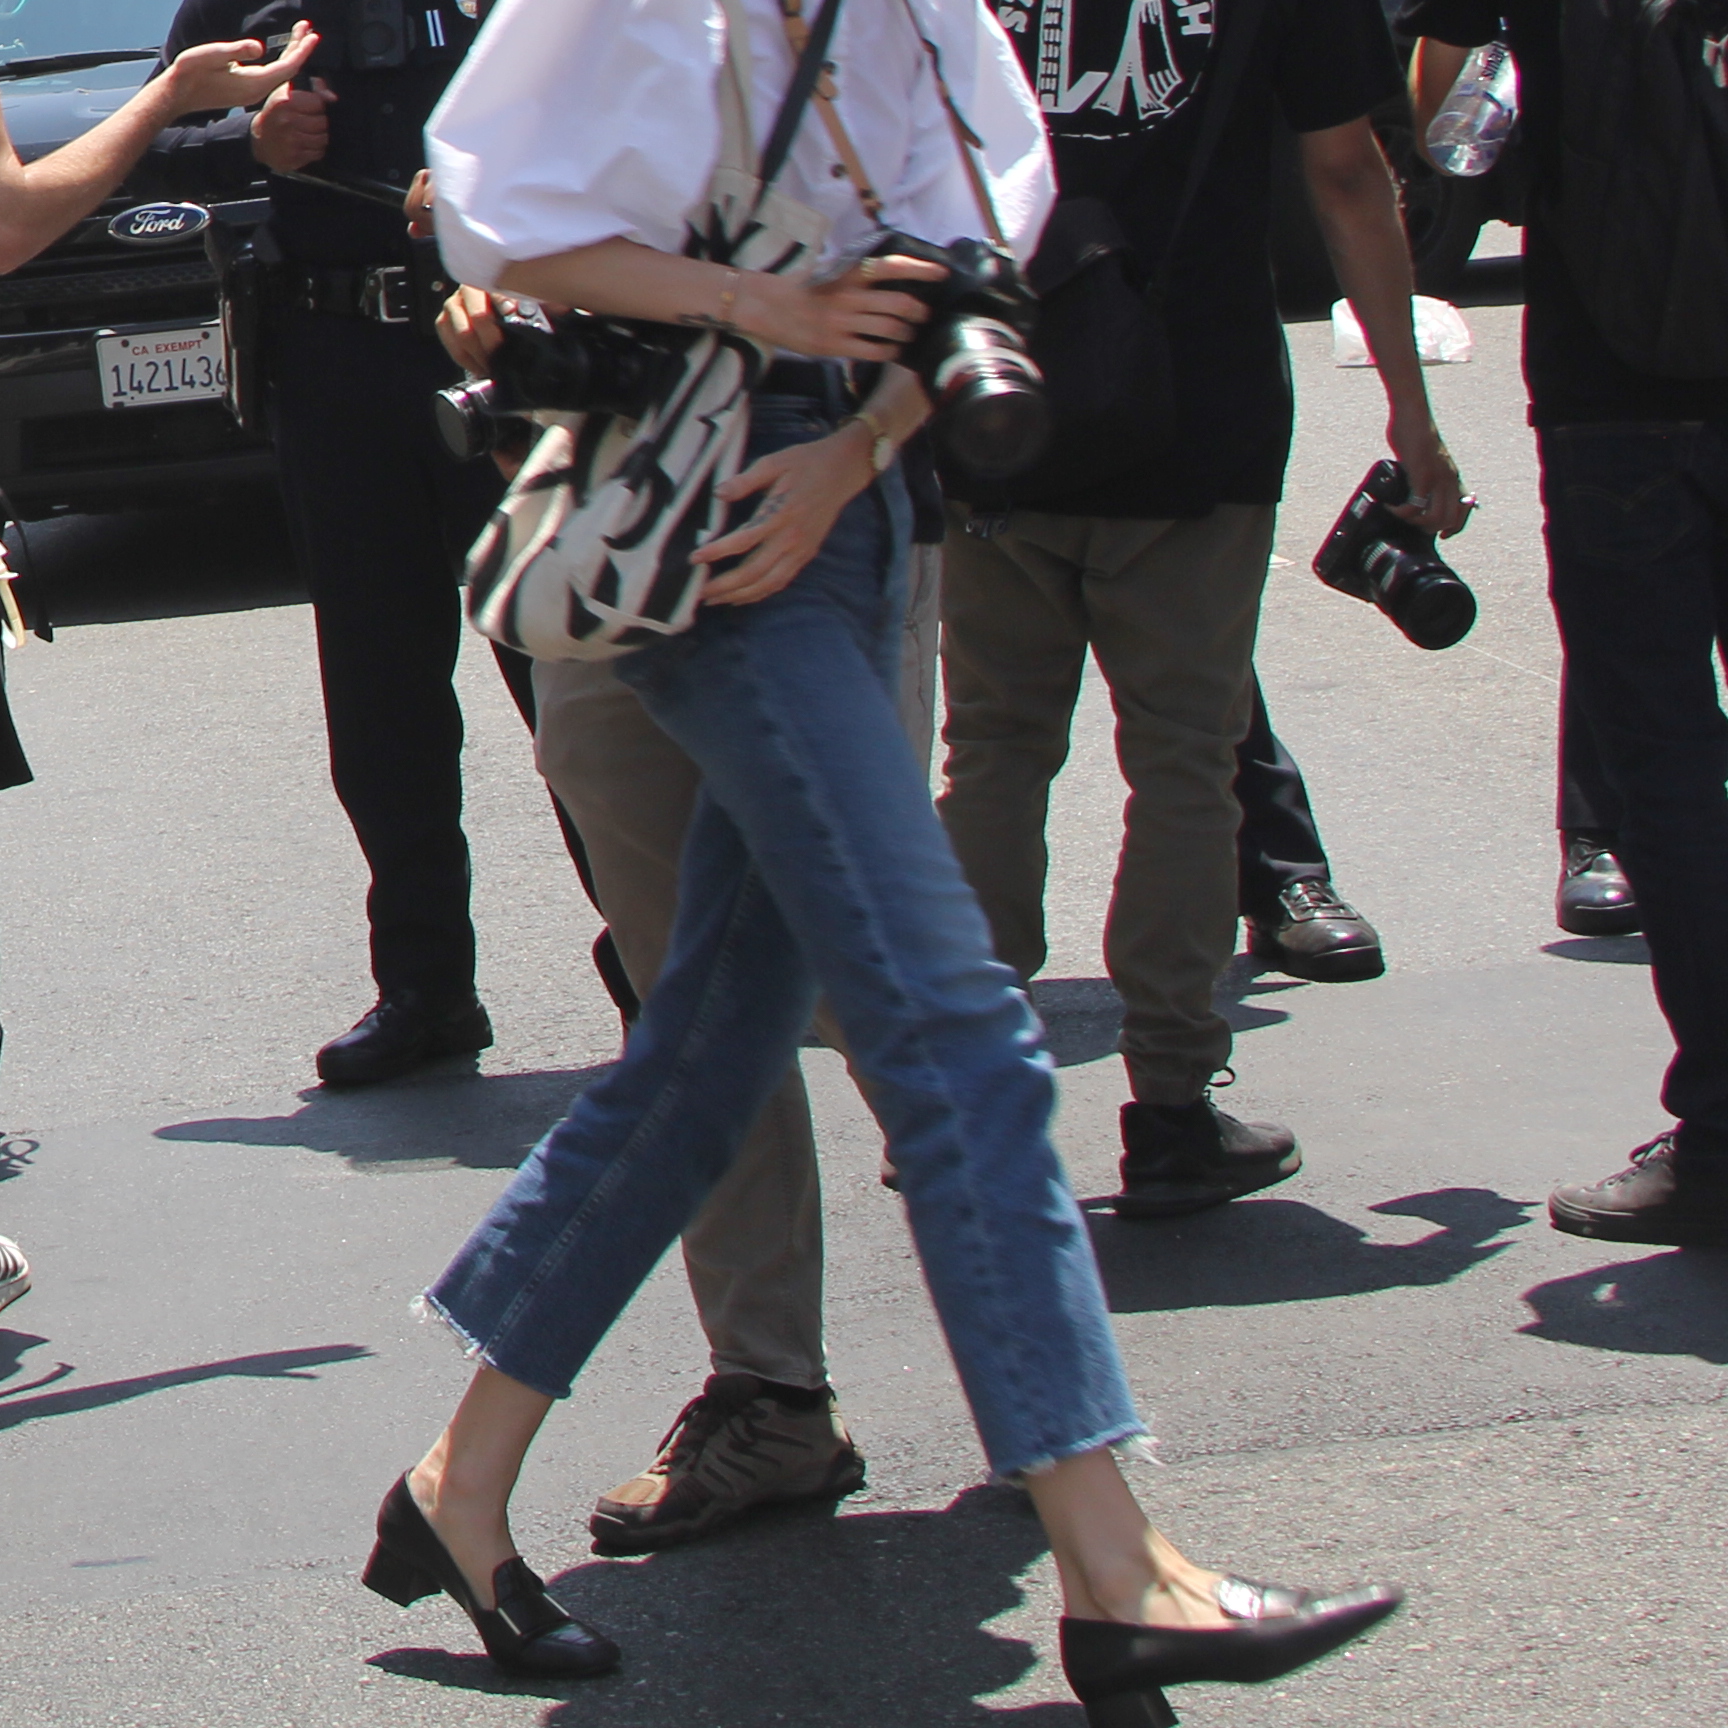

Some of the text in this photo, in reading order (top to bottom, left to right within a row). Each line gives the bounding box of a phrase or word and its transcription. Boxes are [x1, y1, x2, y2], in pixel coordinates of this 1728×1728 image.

[129, 208, 185, 235] Ford
[132, 339, 203, 356] CA EXEMPT
